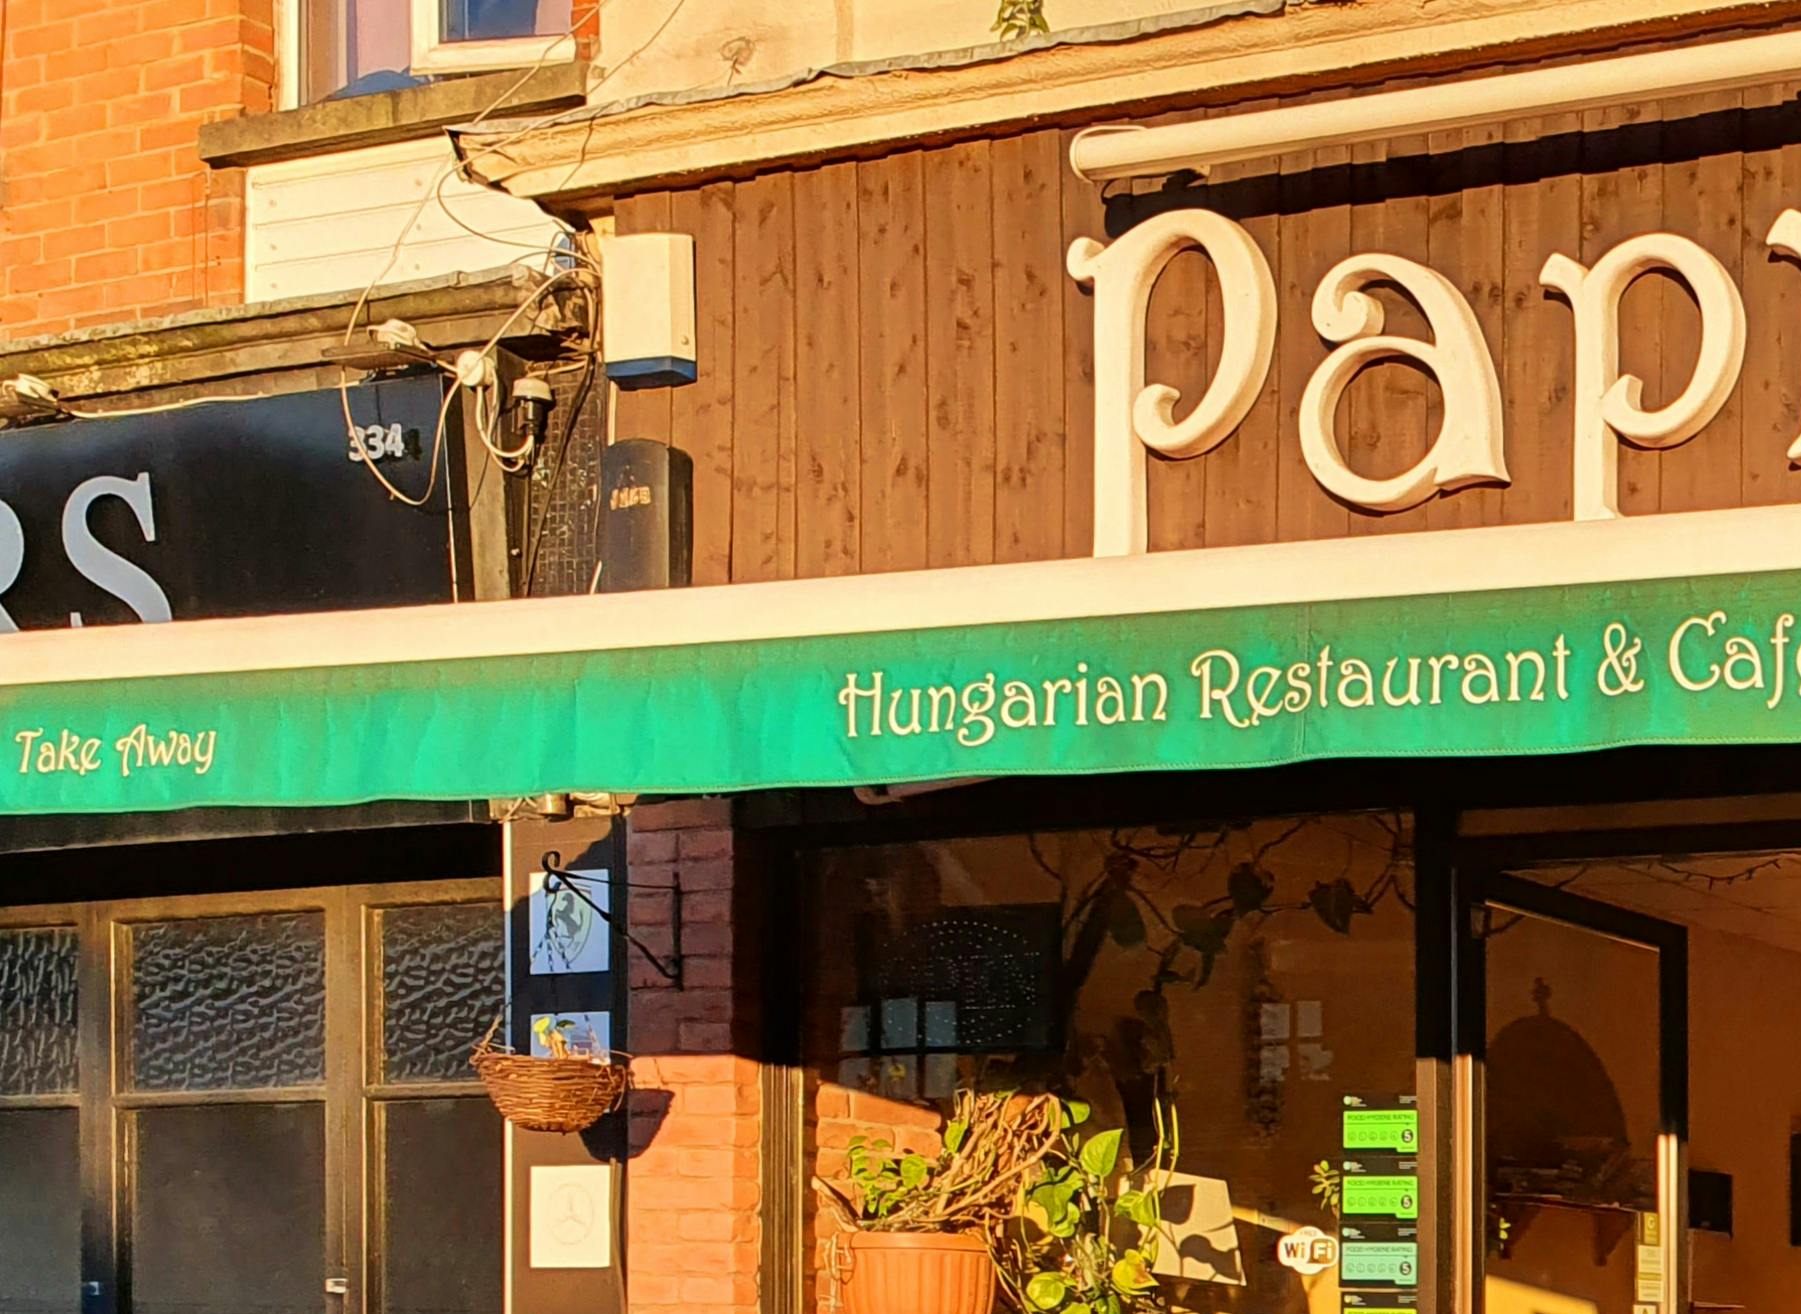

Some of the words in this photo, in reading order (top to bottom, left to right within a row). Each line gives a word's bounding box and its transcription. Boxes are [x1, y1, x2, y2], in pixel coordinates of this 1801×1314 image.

[348, 422, 405, 462] 334
[0, 471, 173, 634] S
[838, 661, 1168, 747] Hungarian
[1190, 632, 1572, 728] Restaurant
[1597, 622, 1645, 697] &
[15, 727, 102, 776] Take
[115, 723, 217, 777] Away
